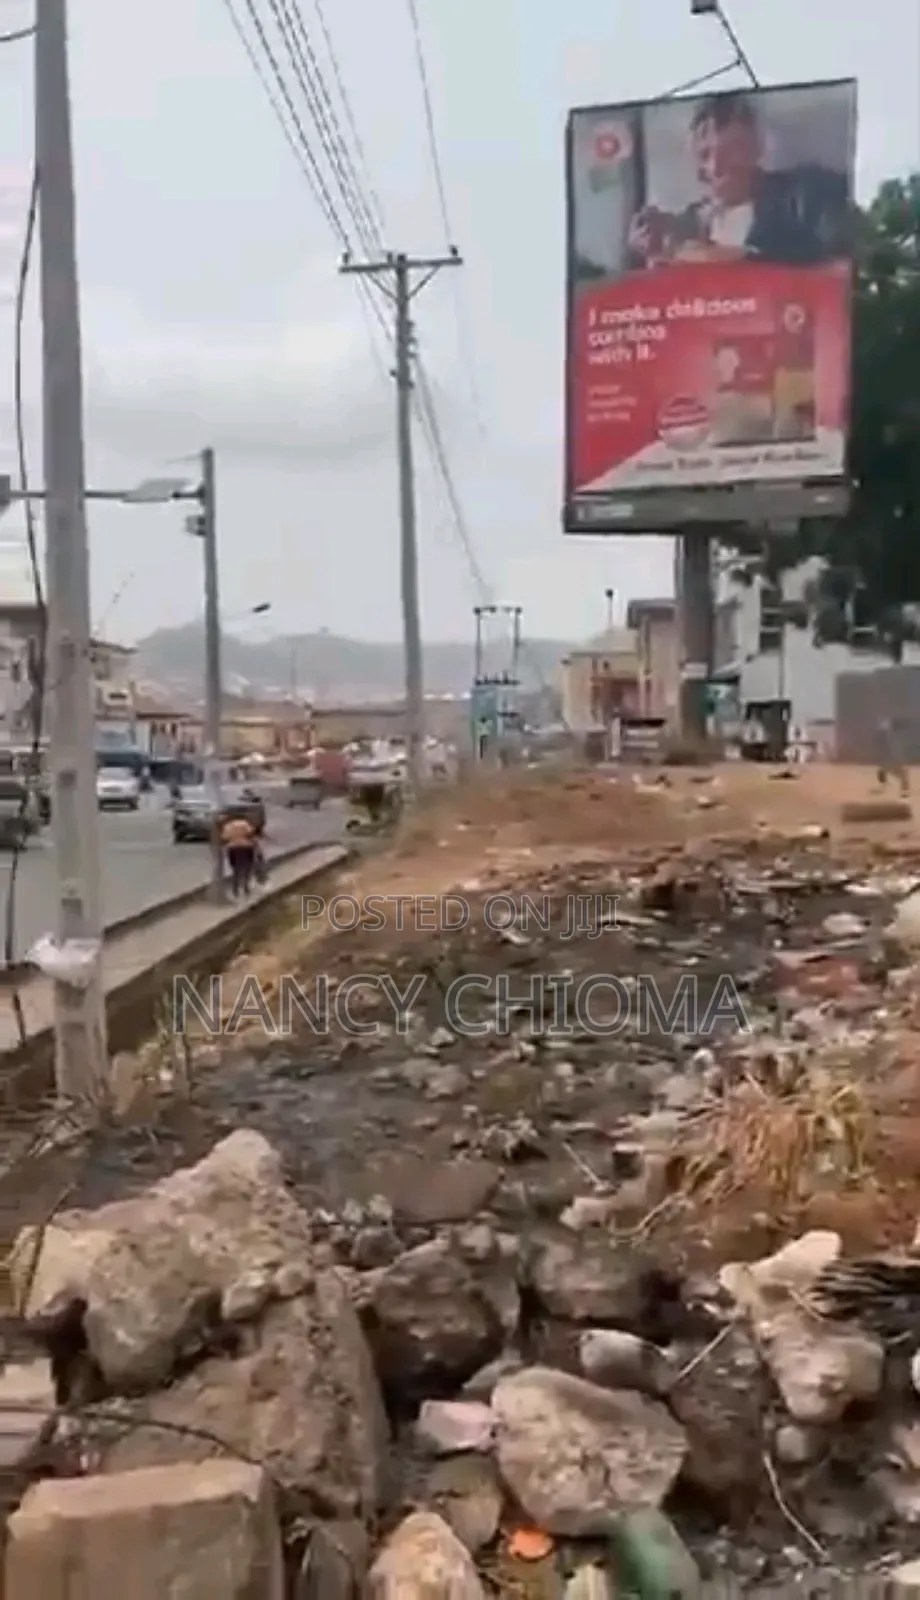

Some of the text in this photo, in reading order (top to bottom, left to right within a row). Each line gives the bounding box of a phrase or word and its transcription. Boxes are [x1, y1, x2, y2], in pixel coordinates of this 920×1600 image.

[588, 297, 758, 326] I make delicious
[588, 346, 631, 365] with
